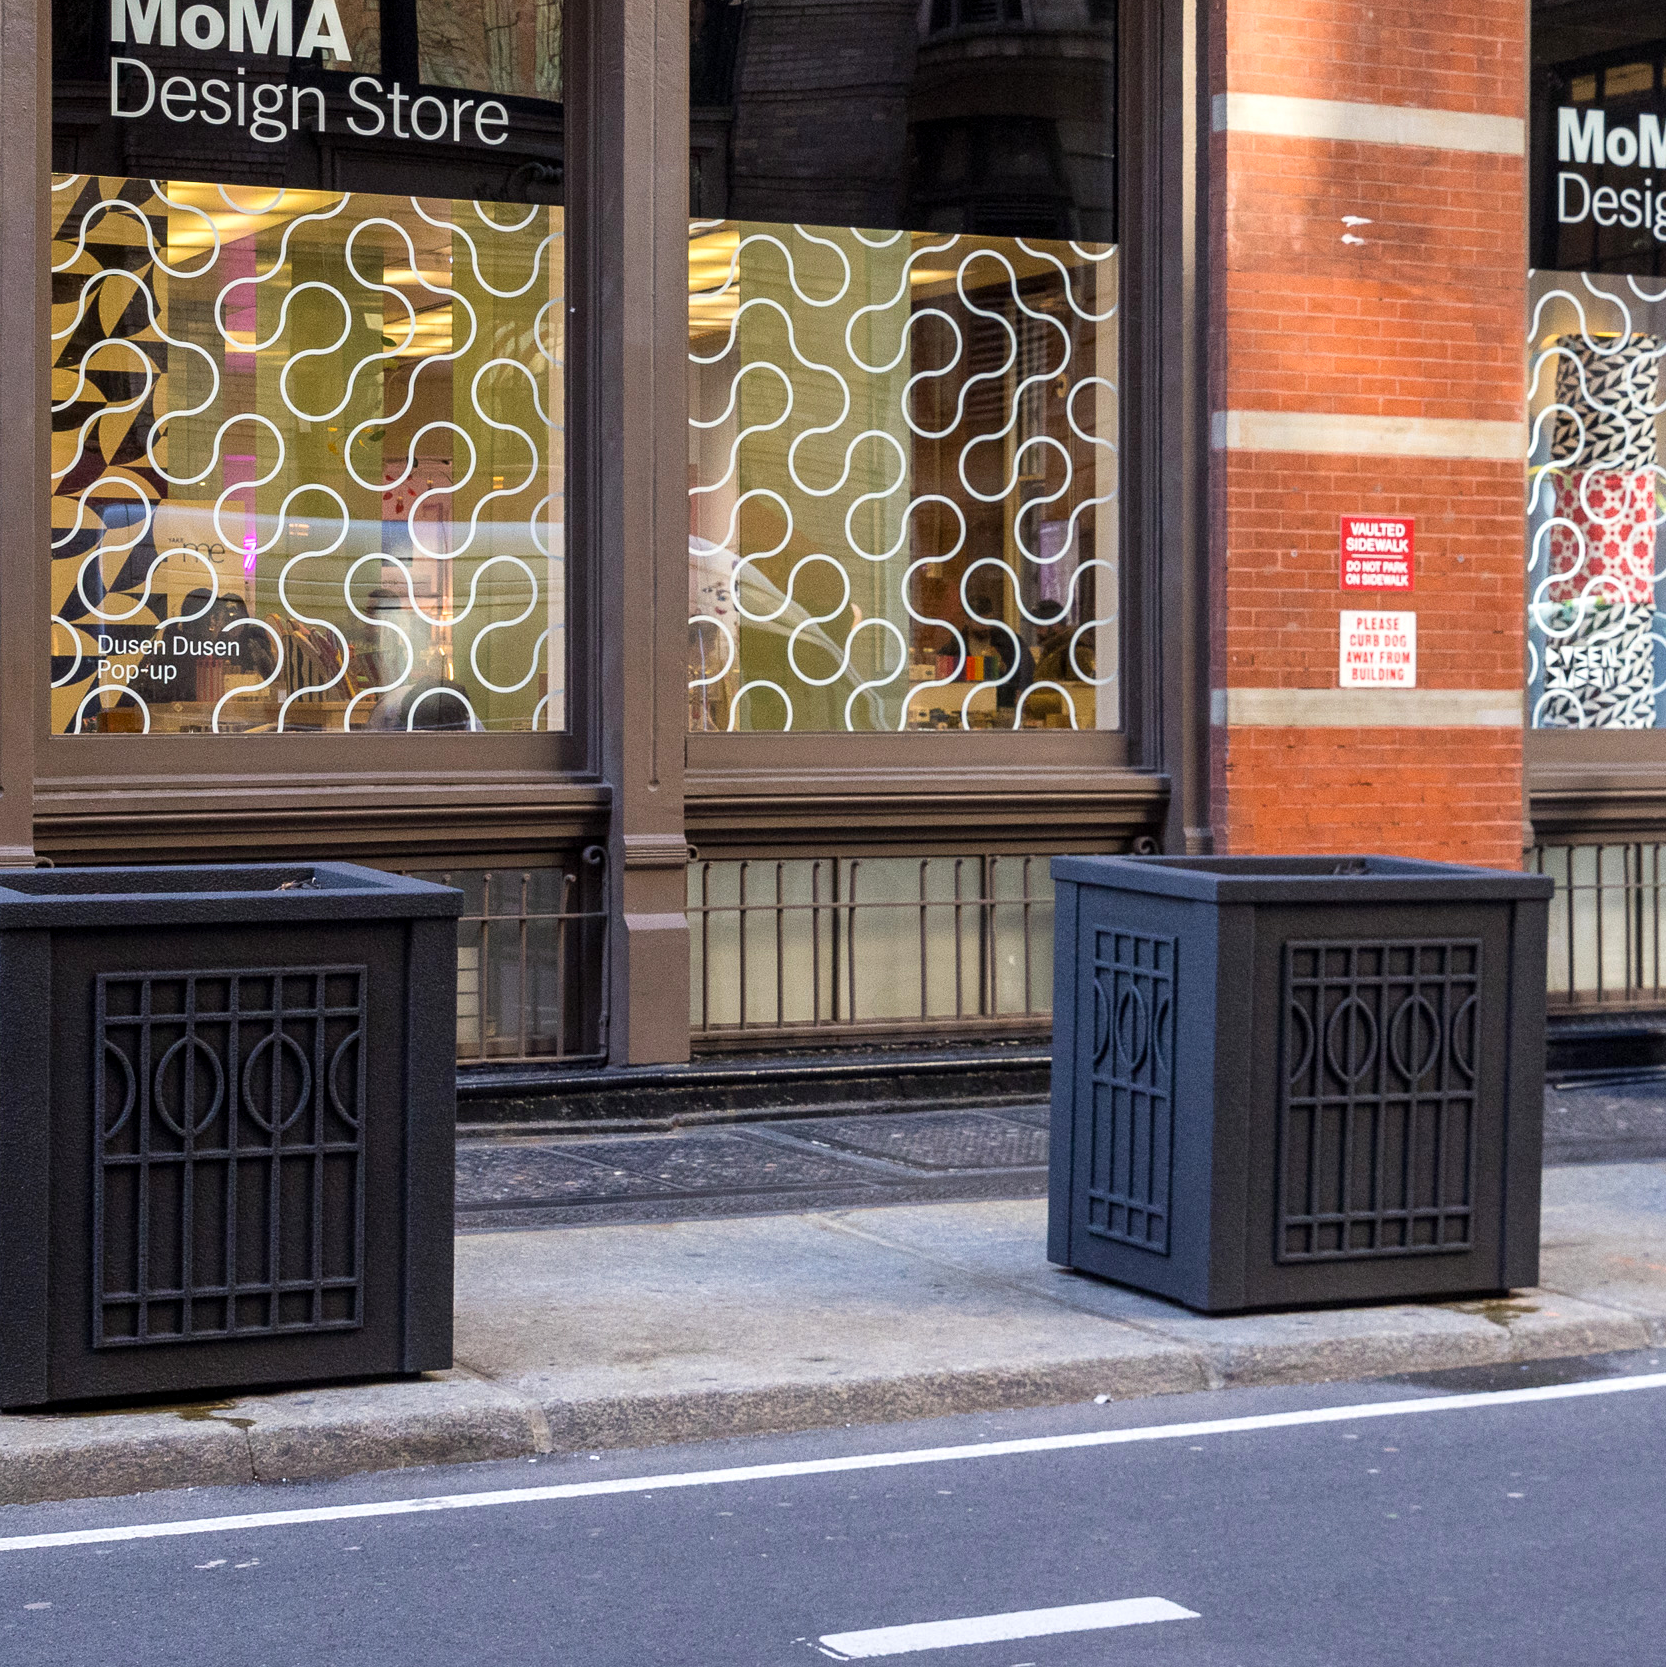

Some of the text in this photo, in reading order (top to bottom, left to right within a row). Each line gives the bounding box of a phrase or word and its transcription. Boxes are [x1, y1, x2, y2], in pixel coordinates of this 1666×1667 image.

[110, 56, 509, 145] Design Store
[1349, 521, 1406, 538] VAULTED
[1345, 536, 1410, 553] SIDEWALK
[1345, 559, 1409, 574] DO NOT PARK
[1345, 572, 1410, 587] ON SIDEWALK
[1356, 617, 1400, 631] PLEASE
[97, 634, 240, 656] Dusen Dusen
[1349, 633, 1407, 648] CURB DOG
[1346, 651, 1411, 664] AWAY FROM
[96, 659, 178, 684] Pop-up
[1351, 668, 1405, 681] BUILDING
